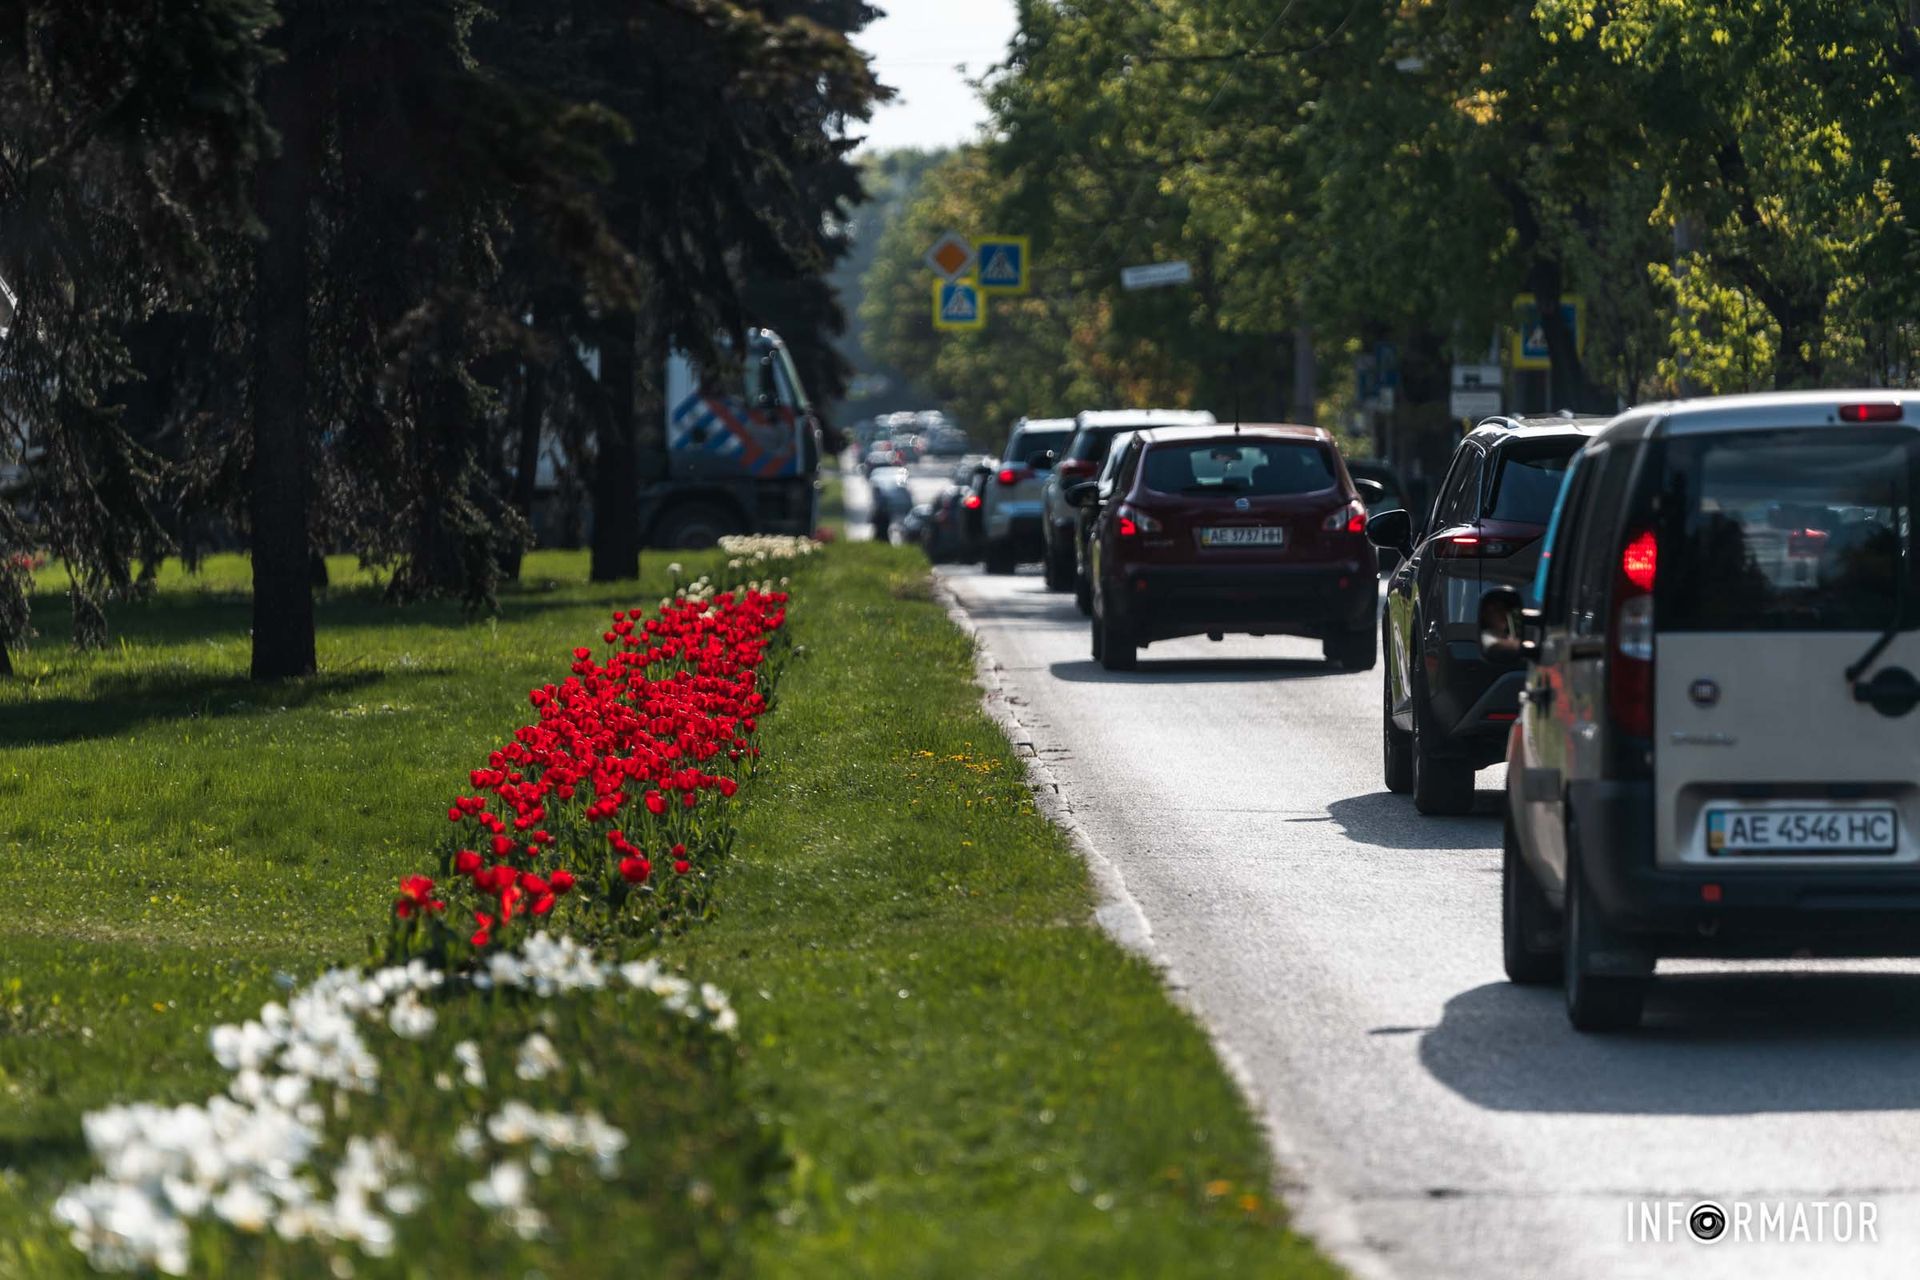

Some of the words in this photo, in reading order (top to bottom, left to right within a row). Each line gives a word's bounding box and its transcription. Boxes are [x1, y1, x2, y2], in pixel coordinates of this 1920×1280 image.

[1212, 527, 1228, 541] AE
[1731, 815, 1769, 843] AE
[1777, 815, 1841, 843] 4546
[1849, 815, 1889, 843] HC
